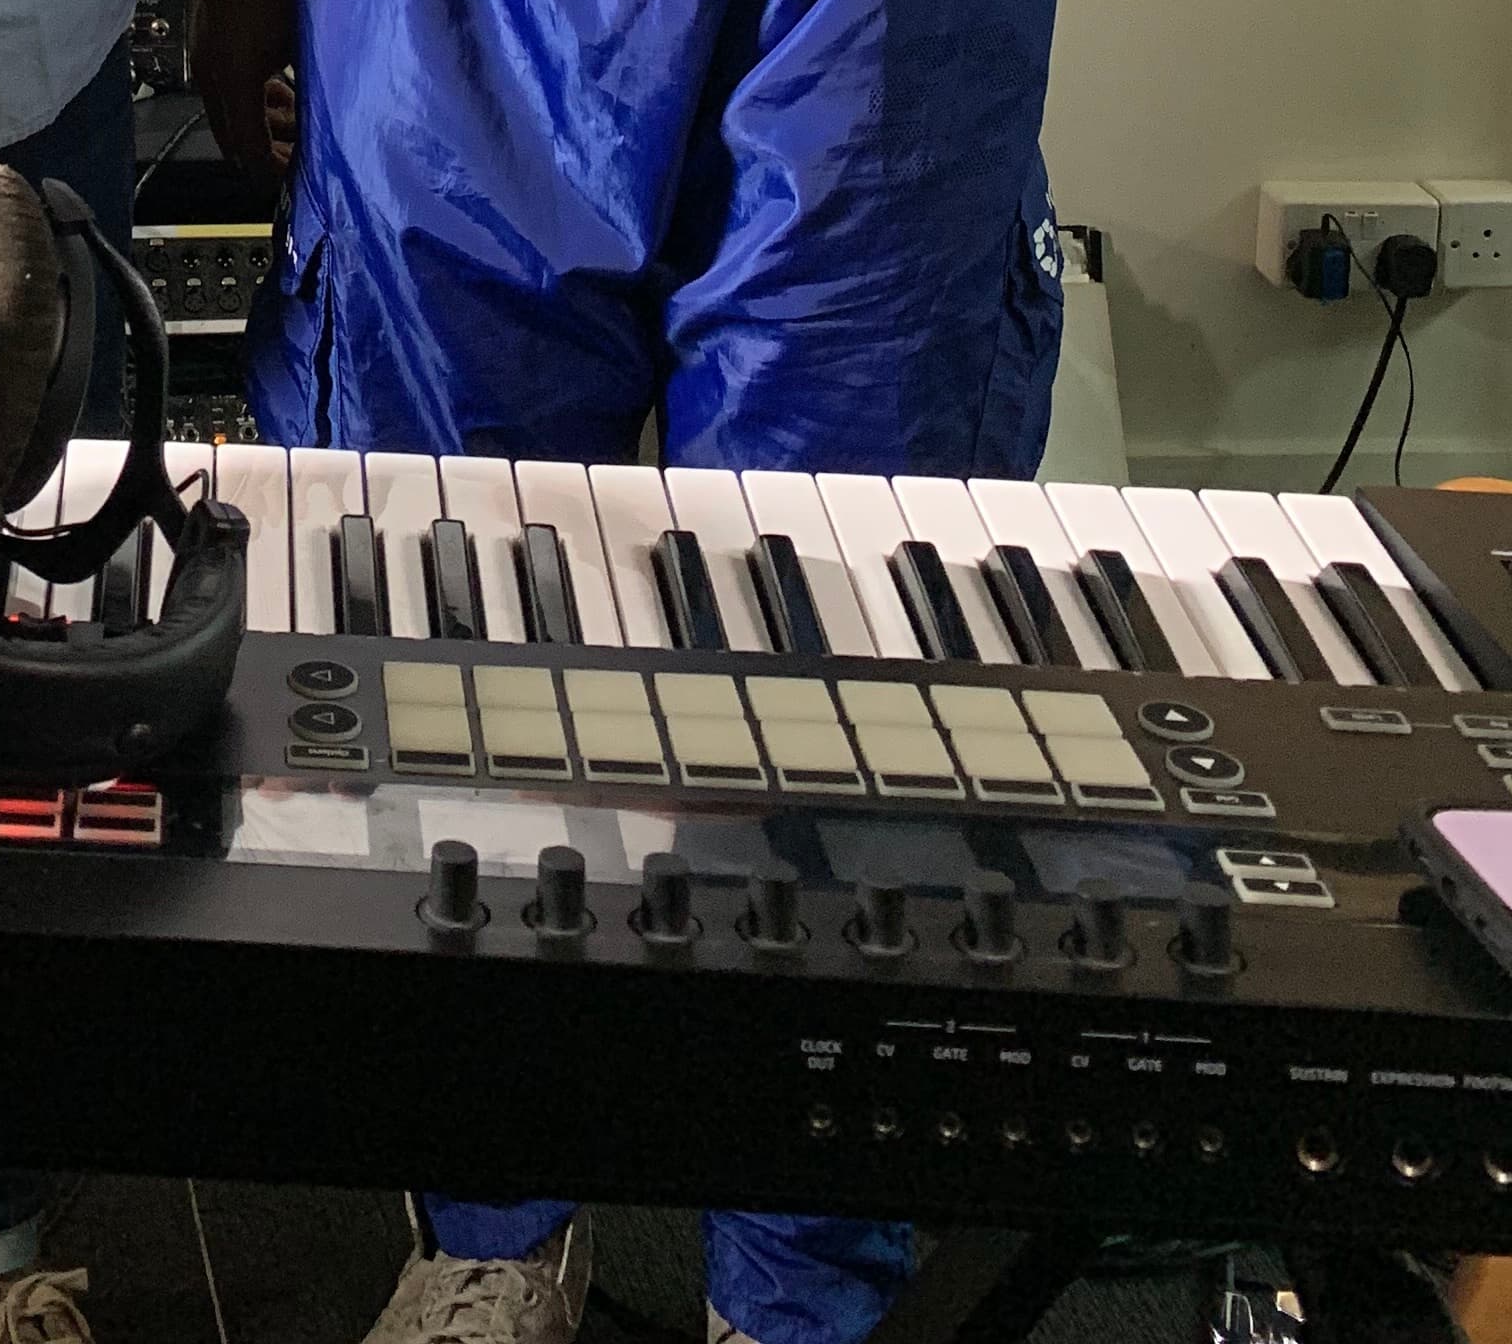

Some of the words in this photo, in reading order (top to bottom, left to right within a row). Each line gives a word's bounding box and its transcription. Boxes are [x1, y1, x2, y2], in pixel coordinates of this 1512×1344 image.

[800, 1039, 843, 1055] CLOCK
[876, 1044, 896, 1058] CV
[933, 1048, 969, 1063] GATE
[1071, 1055, 1090, 1069] CV
[808, 1057, 836, 1072] OUT
[1128, 1058, 1163, 1073] GATE
